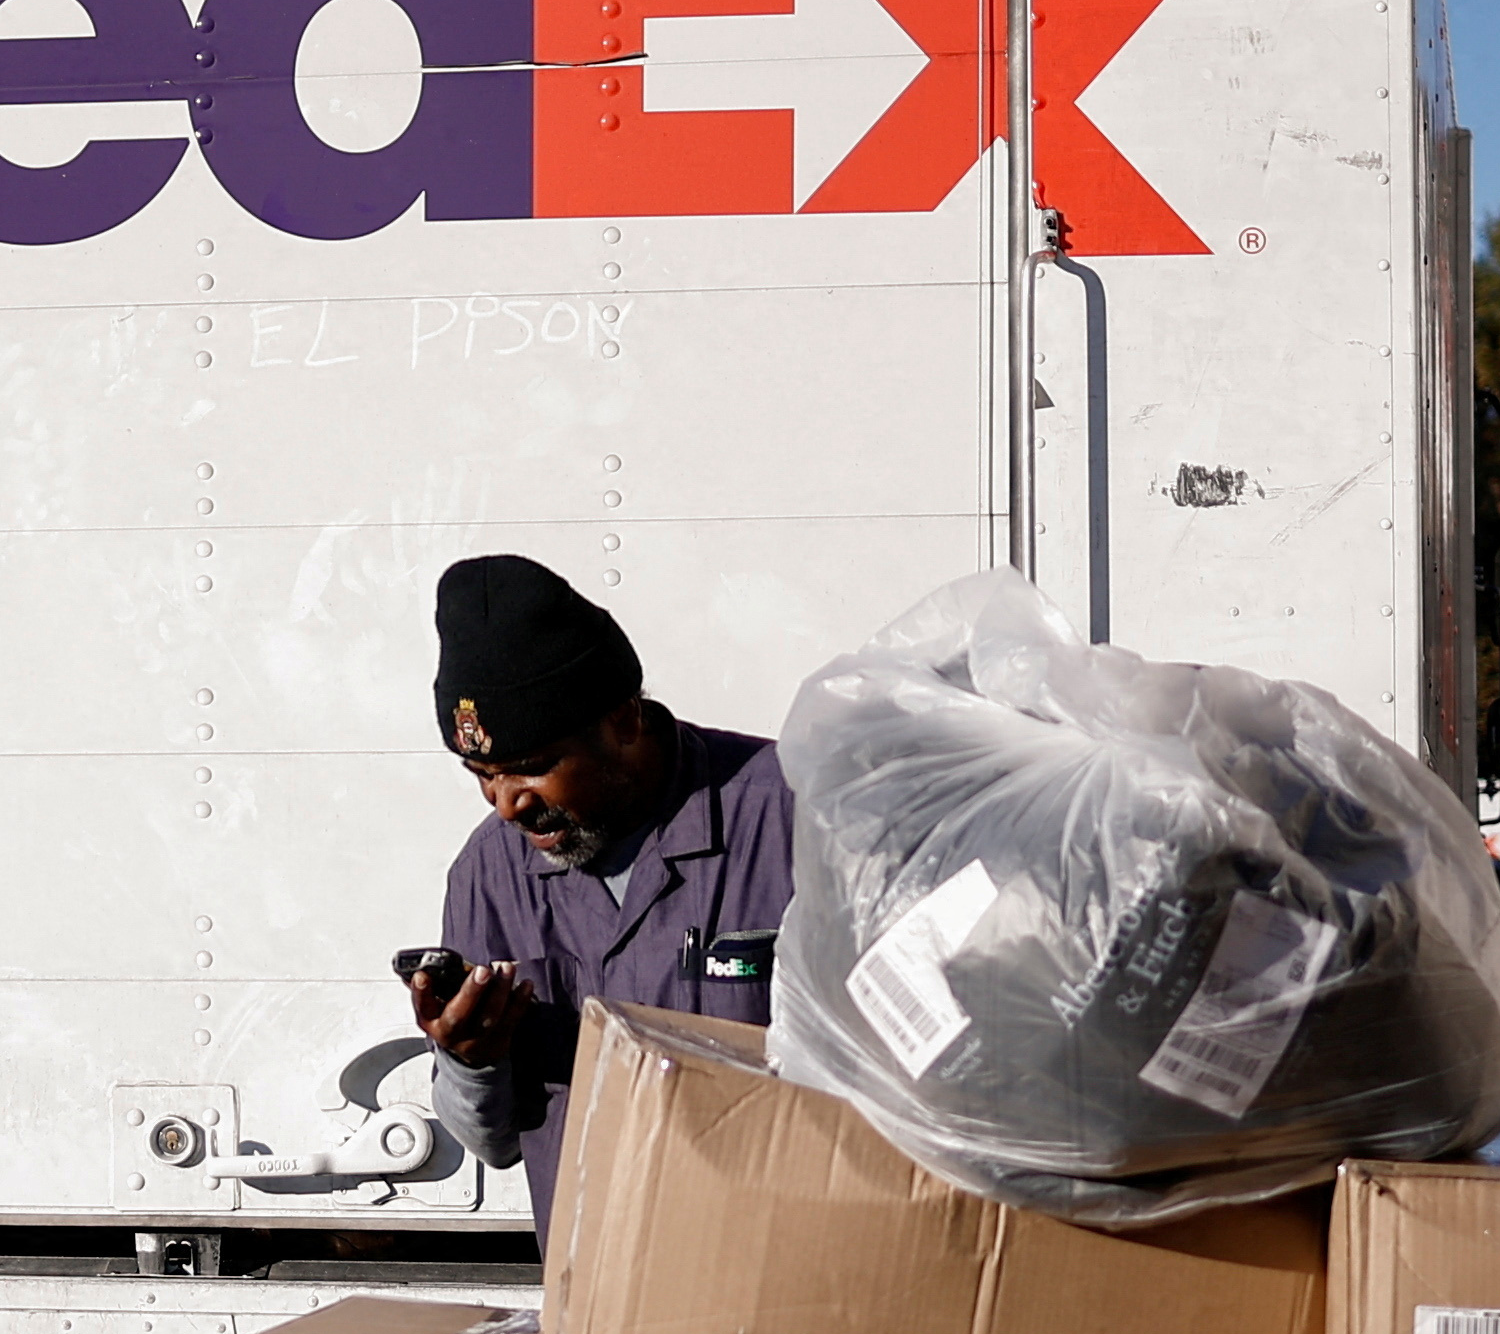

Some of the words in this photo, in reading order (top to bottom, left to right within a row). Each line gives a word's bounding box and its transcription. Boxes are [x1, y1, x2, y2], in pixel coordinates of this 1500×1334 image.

[250, 295, 360, 368] EL
[706, 956, 757, 977] FedEx
[1126, 897, 1195, 986] Fitch
[1115, 984, 1148, 1014] &
